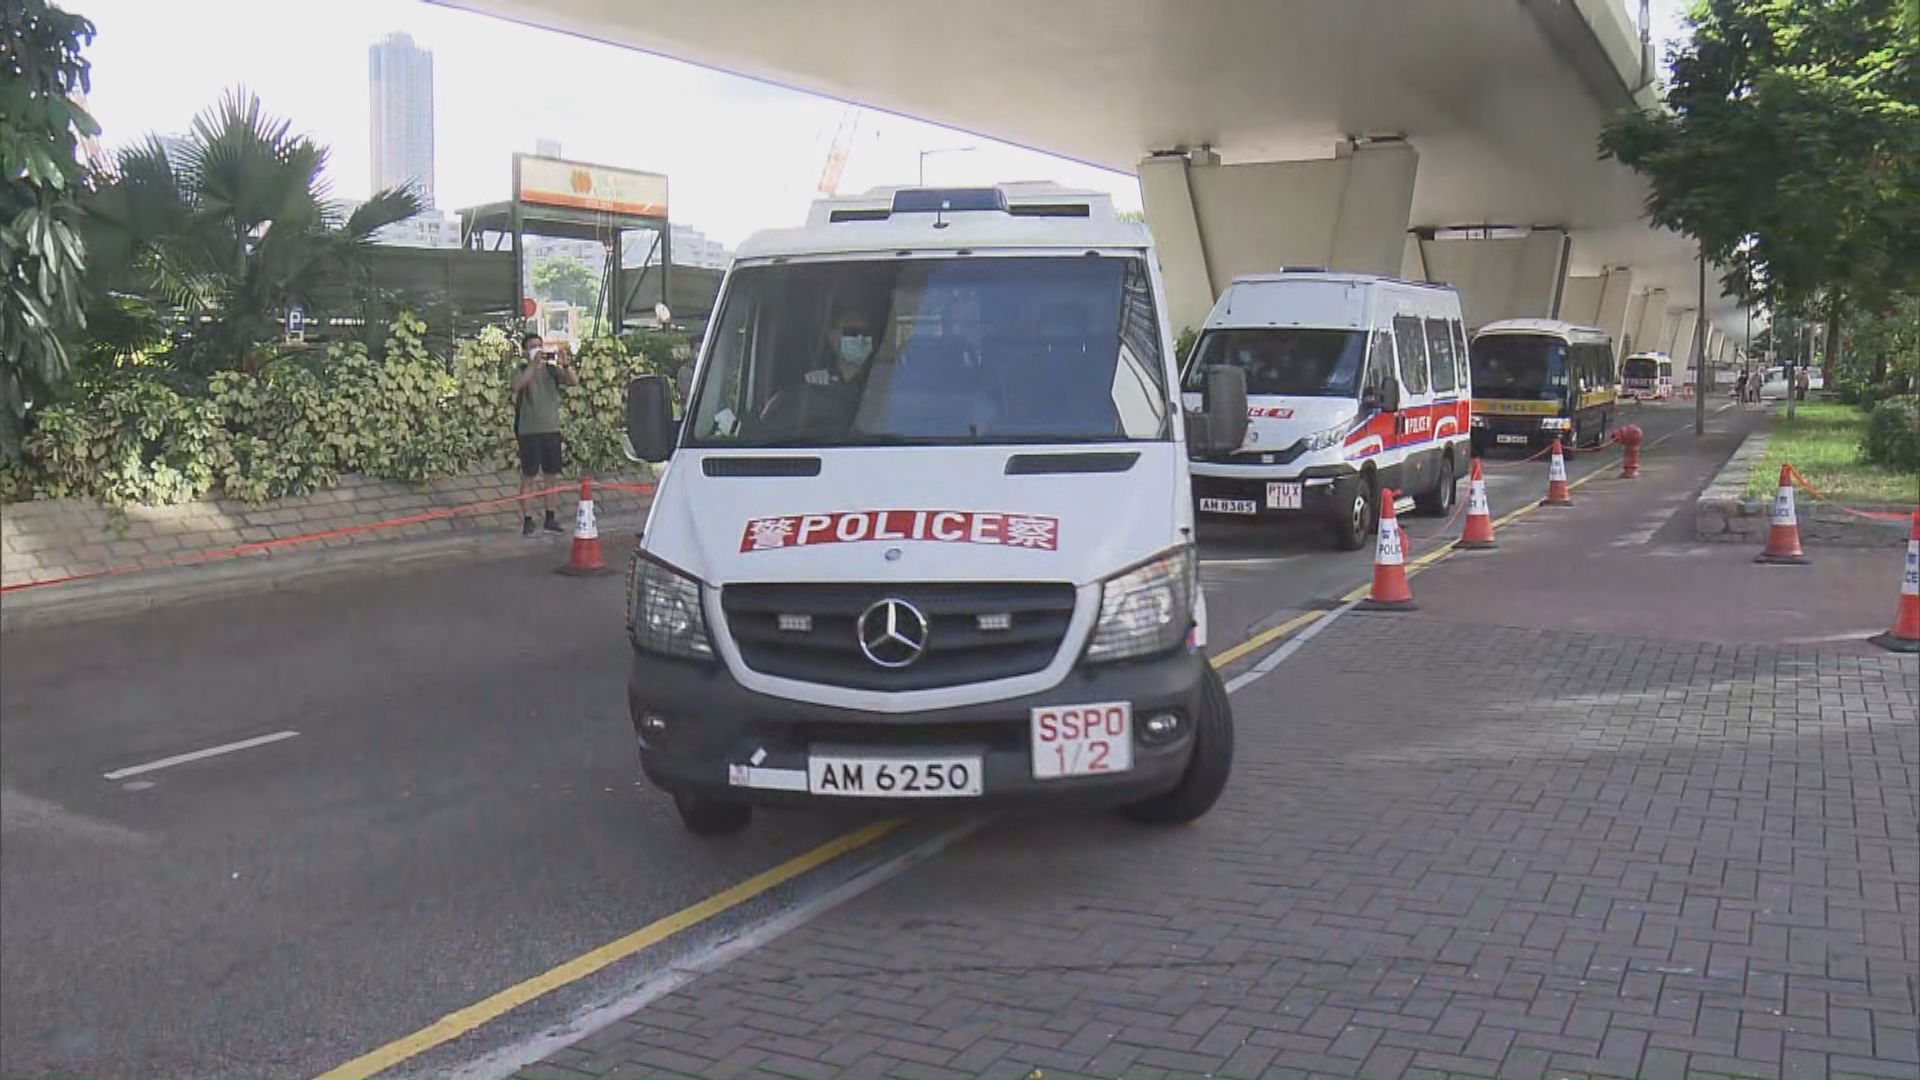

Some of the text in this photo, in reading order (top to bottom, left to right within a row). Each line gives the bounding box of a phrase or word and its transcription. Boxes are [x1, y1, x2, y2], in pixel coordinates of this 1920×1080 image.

[1039, 707, 1123, 742] SSPO
[1055, 740, 1110, 776] 1/2
[820, 762, 969, 792] AM 6250
